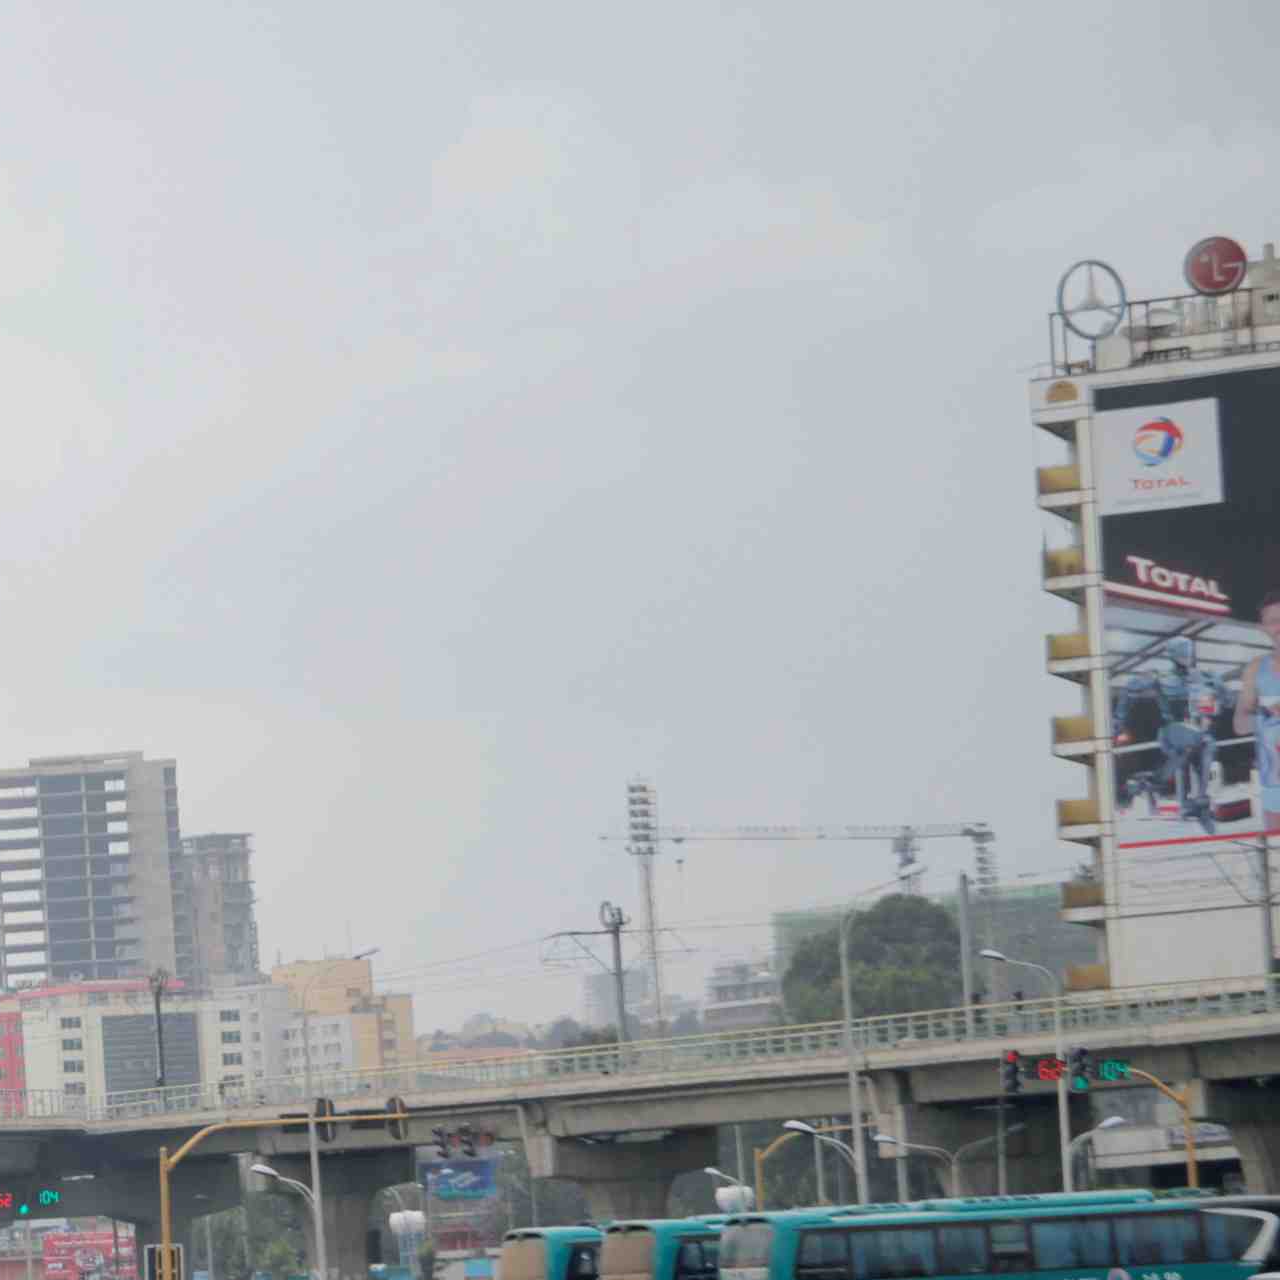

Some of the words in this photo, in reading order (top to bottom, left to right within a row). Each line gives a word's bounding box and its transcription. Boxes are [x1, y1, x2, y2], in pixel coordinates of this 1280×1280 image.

[1131, 476, 1192, 491] TOTAL
[1126, 555, 1229, 599] TOTAL
[40, 1189, 60, 1205] 104
